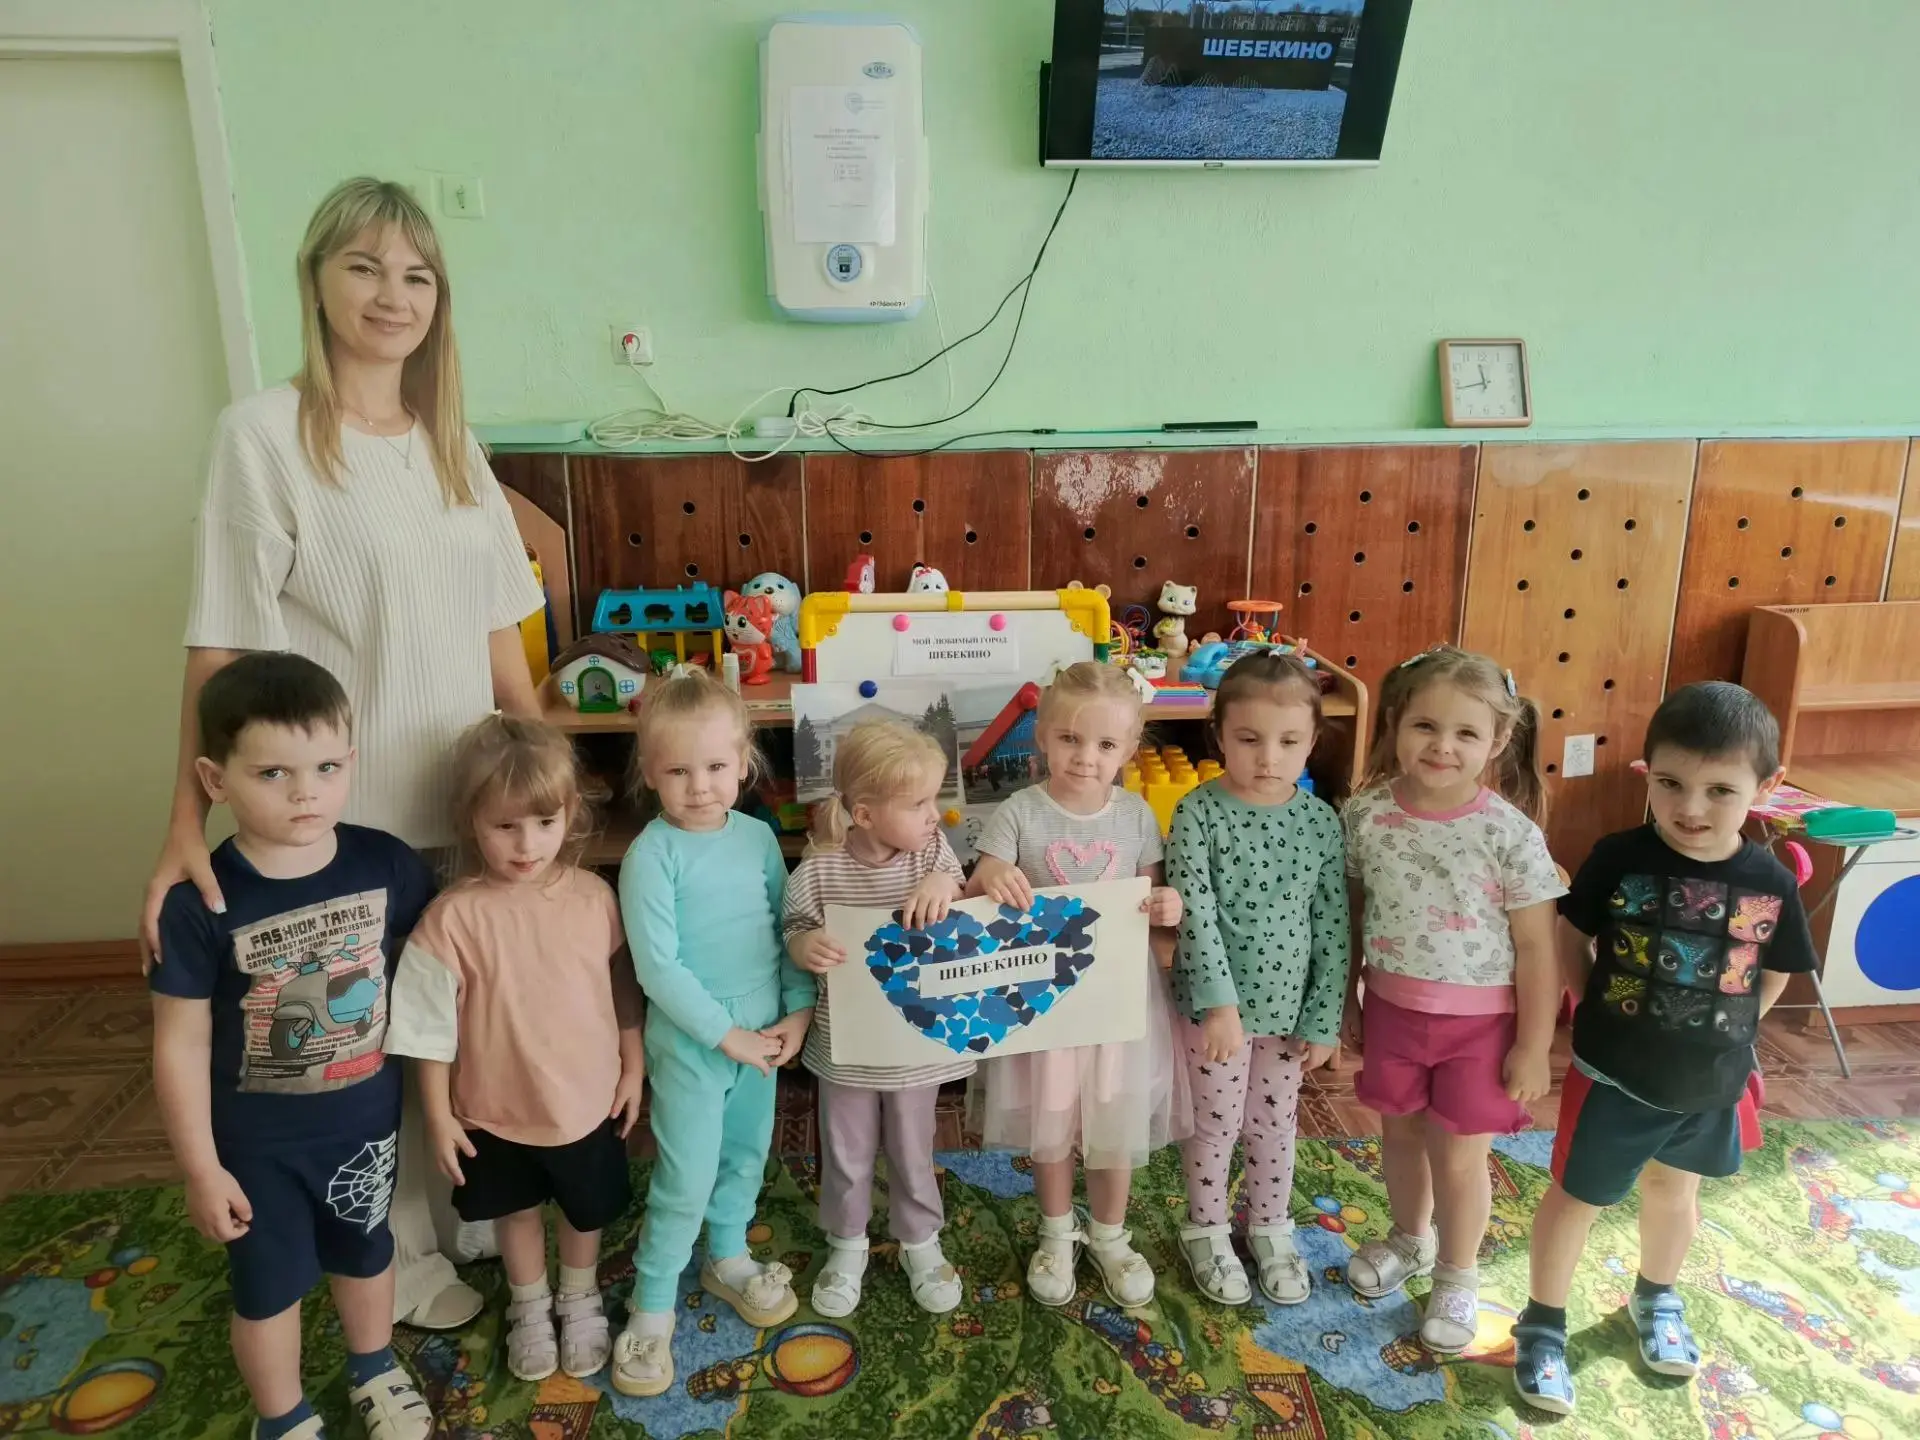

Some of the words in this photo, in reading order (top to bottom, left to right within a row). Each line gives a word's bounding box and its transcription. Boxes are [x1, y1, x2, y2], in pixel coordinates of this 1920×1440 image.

[1202, 37, 1333, 60] ШЕБЕКИНО
[912, 635, 931, 646] МОЙ
[980, 634, 1008, 645] ГОРОД
[928, 649, 991, 660] ШЕБЕКИНО
[249, 916, 317, 950] FASHION
[939, 951, 1048, 982] ШЕБЕКИНО
